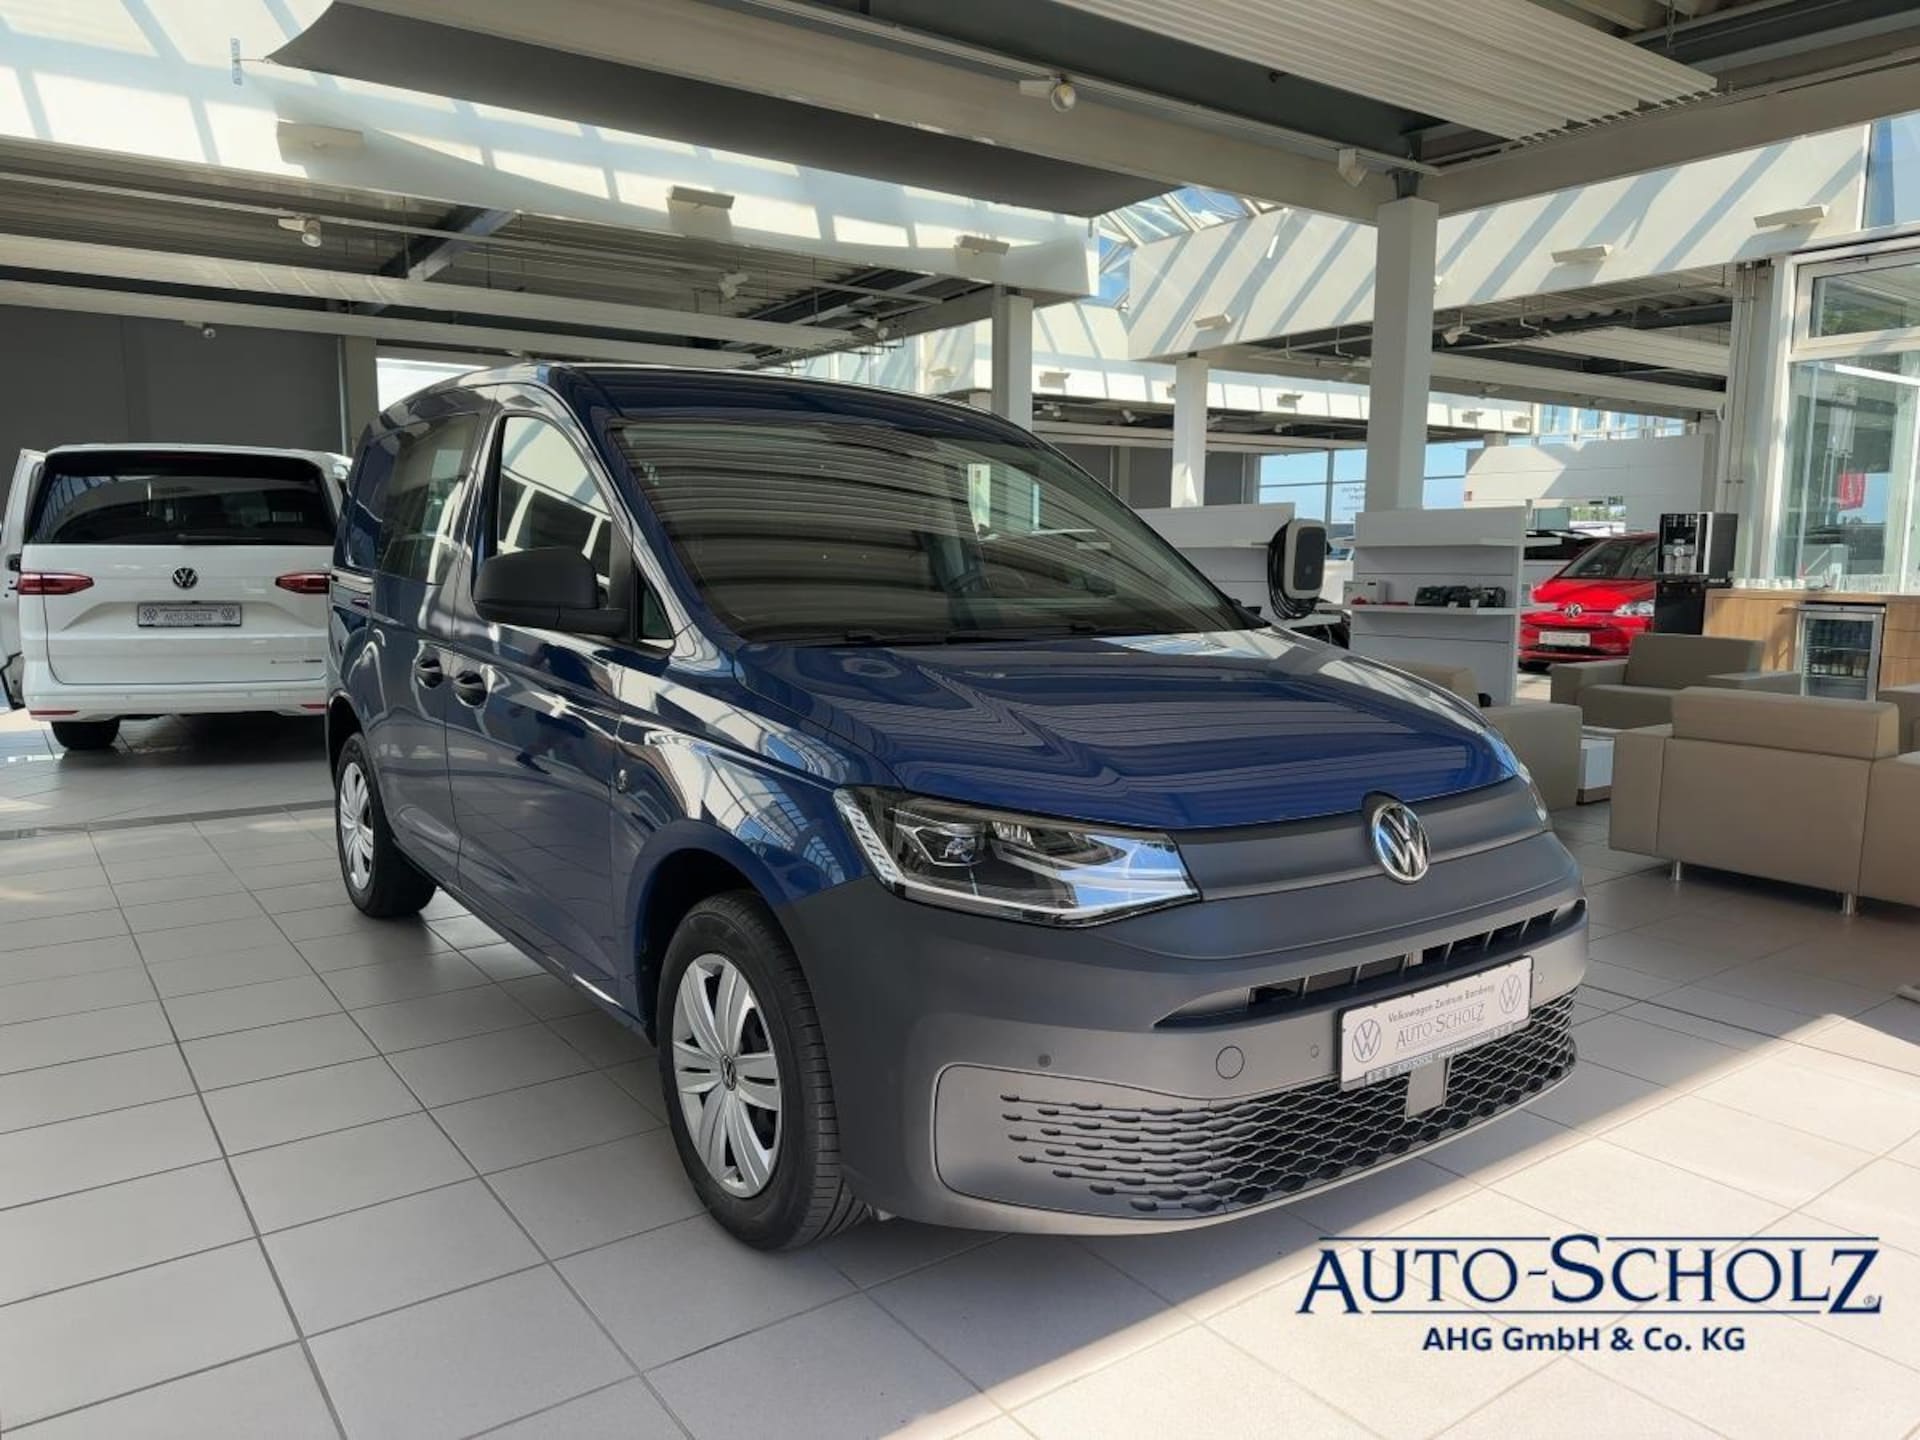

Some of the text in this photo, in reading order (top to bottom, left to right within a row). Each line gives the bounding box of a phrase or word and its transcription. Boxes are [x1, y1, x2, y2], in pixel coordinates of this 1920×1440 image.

[1372, 803, 1431, 881] VW
[1352, 1019, 1381, 1062] VW
[1396, 1004, 1486, 1049] AUTO SCHOLZ
